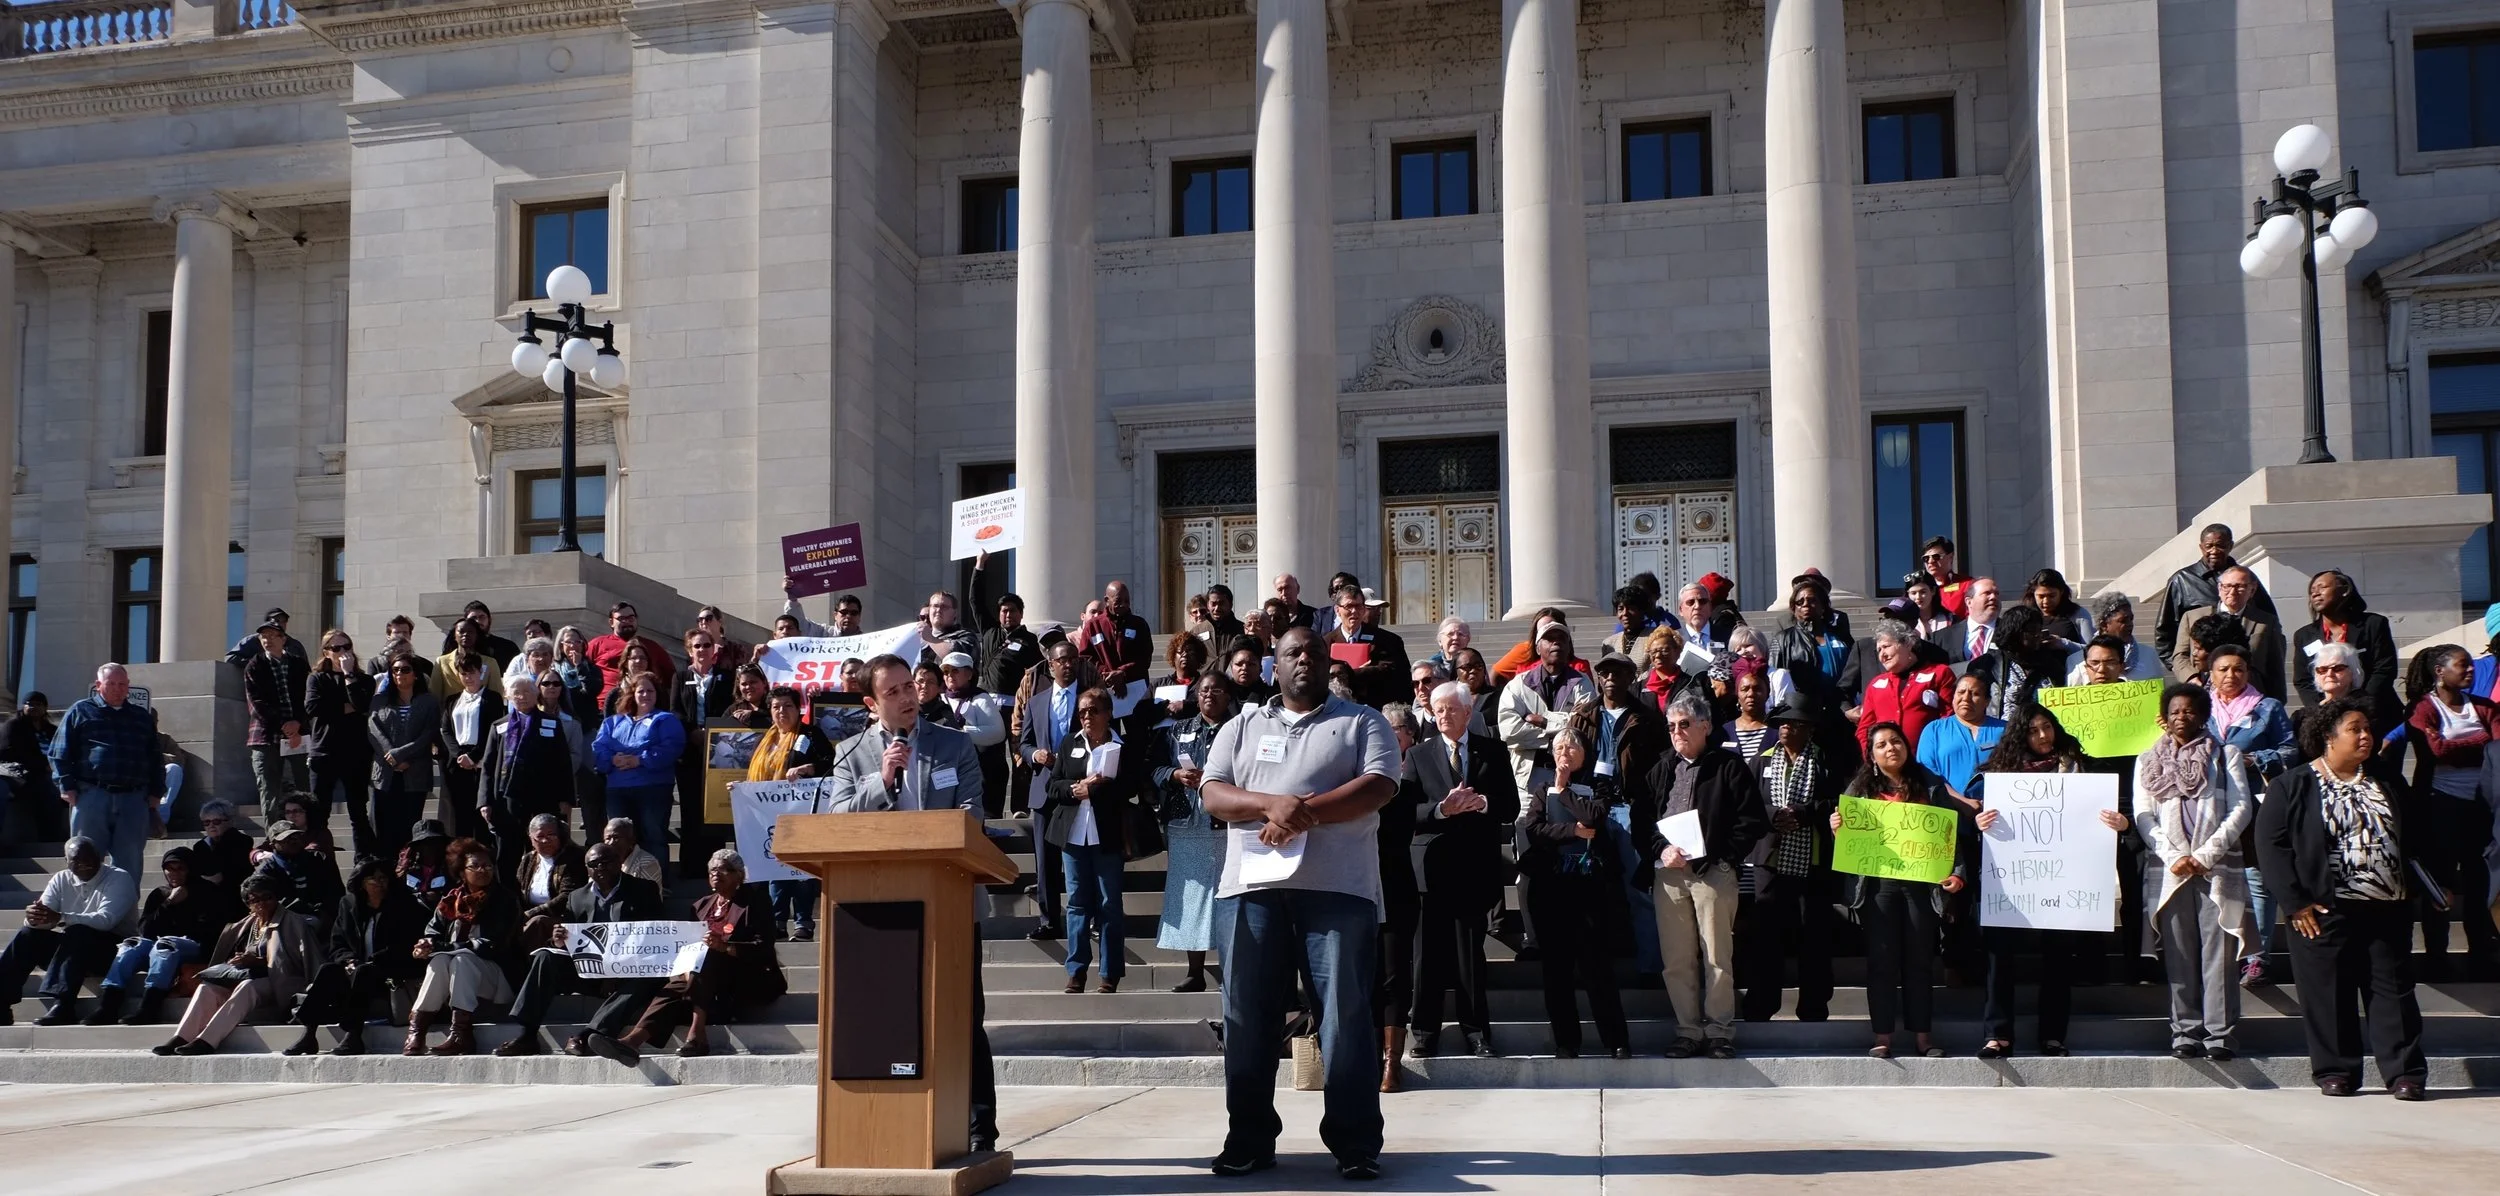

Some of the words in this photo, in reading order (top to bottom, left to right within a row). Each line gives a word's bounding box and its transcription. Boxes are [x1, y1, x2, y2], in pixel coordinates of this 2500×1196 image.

[965, 504, 979, 512] LIKE
[990, 496, 1015, 507] CHICKEN
[960, 511, 979, 520] WINGS
[966, 518, 979, 527] SIDE
[981, 516, 989, 524] OF
[793, 543, 818, 554] POULTRY
[819, 537, 853, 549] COMPANIES
[806, 547, 840, 561] EXPLOIT
[790, 560, 827, 573] VULNERABLE
[2061, 706, 2093, 724] NO
[2100, 701, 2143, 720] WAY
[1844, 801, 1894, 831] SAY
[1879, 827, 1899, 845] 2
[1987, 863, 2007, 879] to
[2011, 859, 2066, 886] HB1042
[1987, 893, 2036, 915] HB1041
[2040, 895, 2061, 909] and
[2065, 889, 2101, 912] SB14
[610, 923, 678, 936] Arkansas
[610, 942, 670, 956] Citizens
